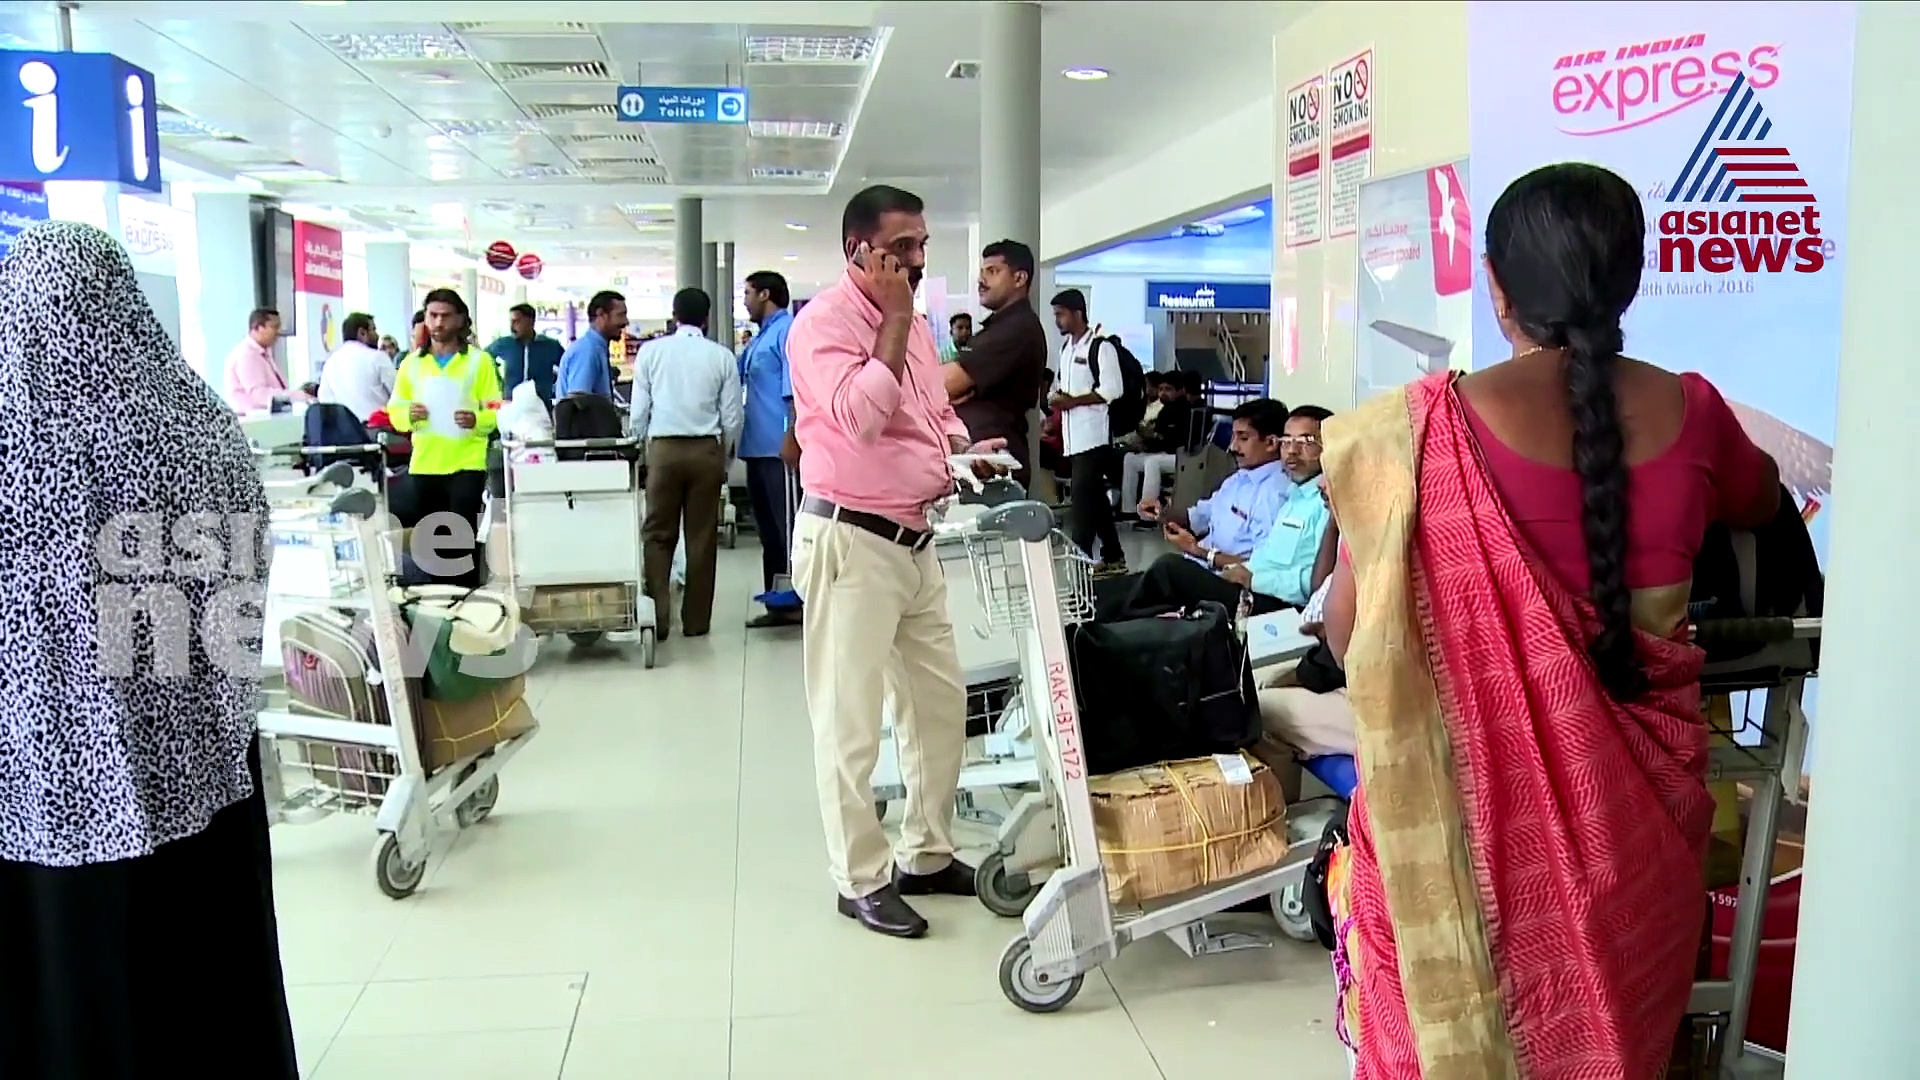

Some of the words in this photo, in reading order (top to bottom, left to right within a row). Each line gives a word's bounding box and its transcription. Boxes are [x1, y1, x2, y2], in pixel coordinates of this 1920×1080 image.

[1553, 51, 1606, 70] AIR
[1615, 33, 1706, 60] INDIA
[1332, 70, 1353, 104] NO
[1552, 45, 1781, 121] express
[659, 107, 705, 118] Toilets
[1289, 93, 1306, 124] NO
[1333, 99, 1369, 129] SMOKING
[1289, 121, 1320, 147] SMOKING
[125, 225, 173, 252] express
[1159, 294, 1215, 308] Restaurant
[1637, 281, 1662, 297] 8th
[1667, 279, 1712, 295] March
[1718, 279, 1754, 294] 2016
[1048, 661, 1082, 782] RAK-BT-172
